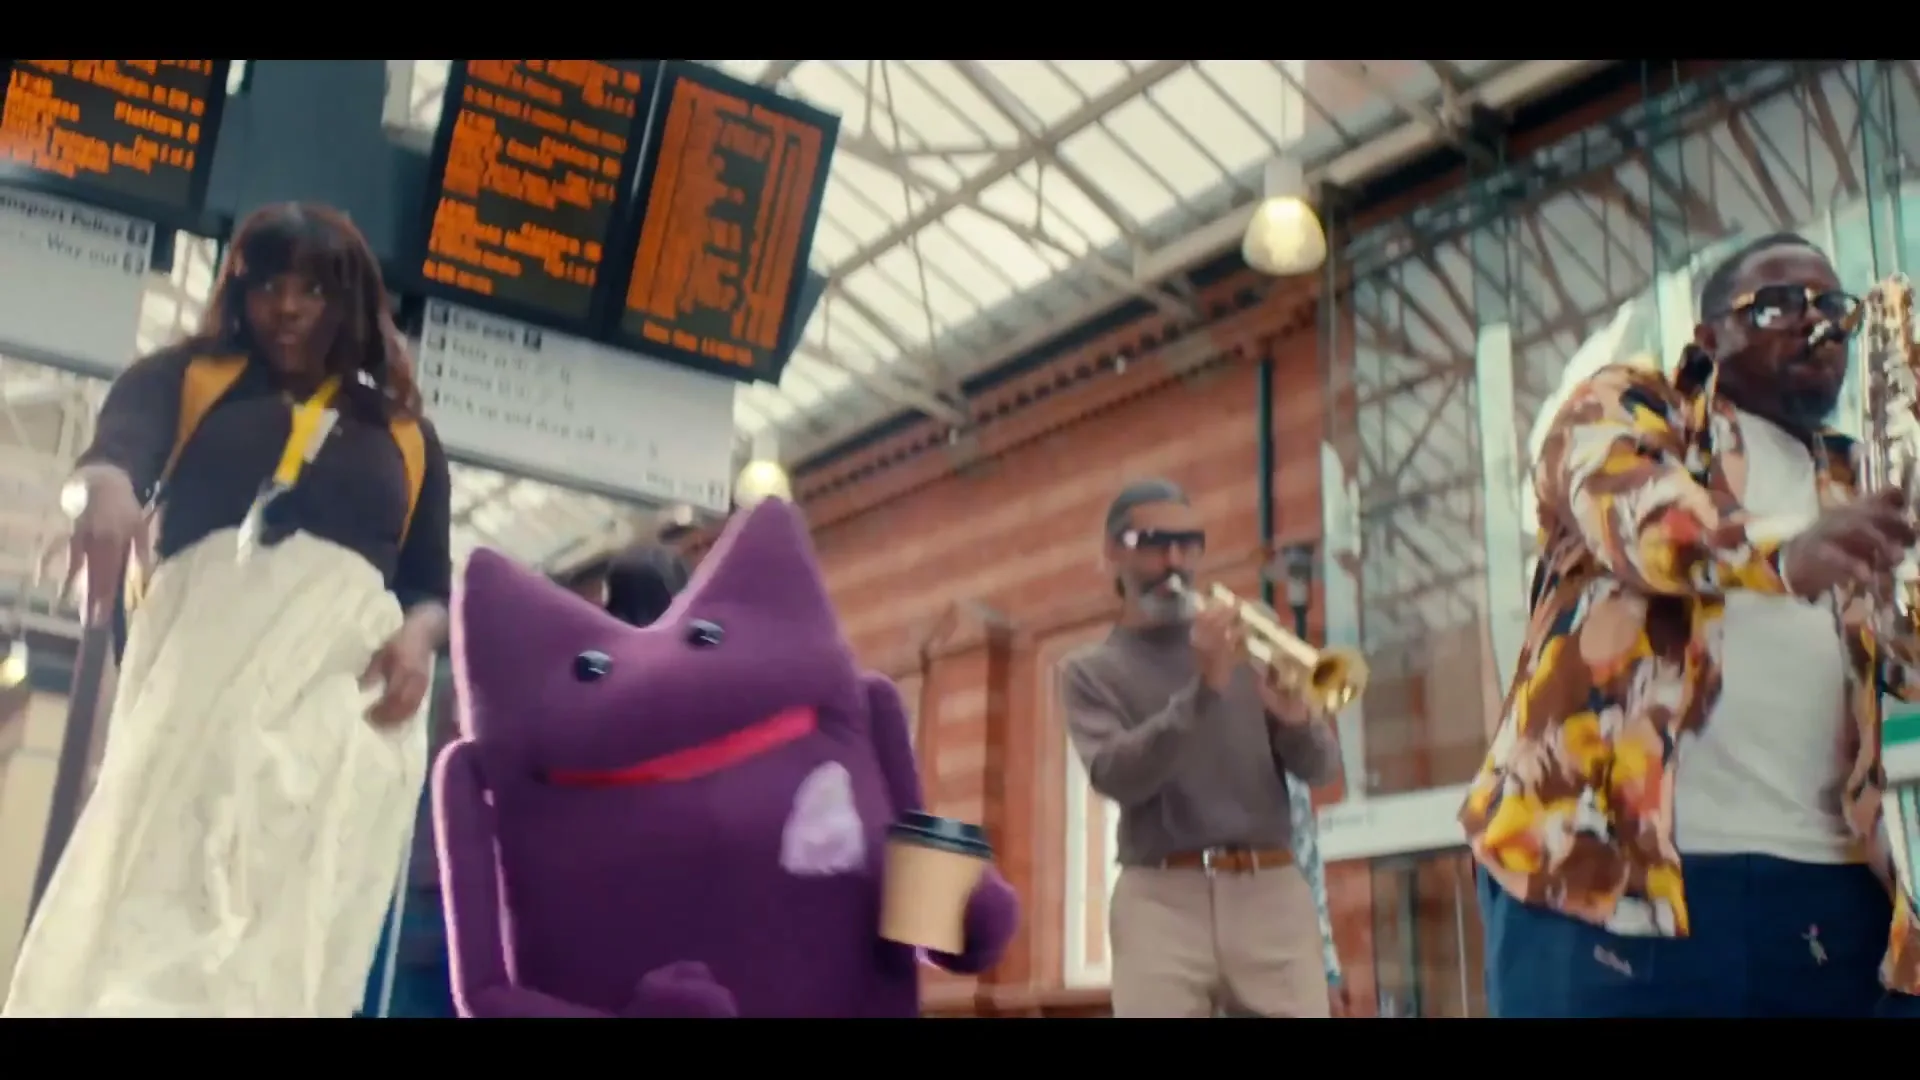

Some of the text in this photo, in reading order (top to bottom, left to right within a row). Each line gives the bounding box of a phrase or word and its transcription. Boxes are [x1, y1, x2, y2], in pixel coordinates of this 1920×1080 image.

[70, 209, 122, 239] Police
[47, 231, 118, 267] Way out
